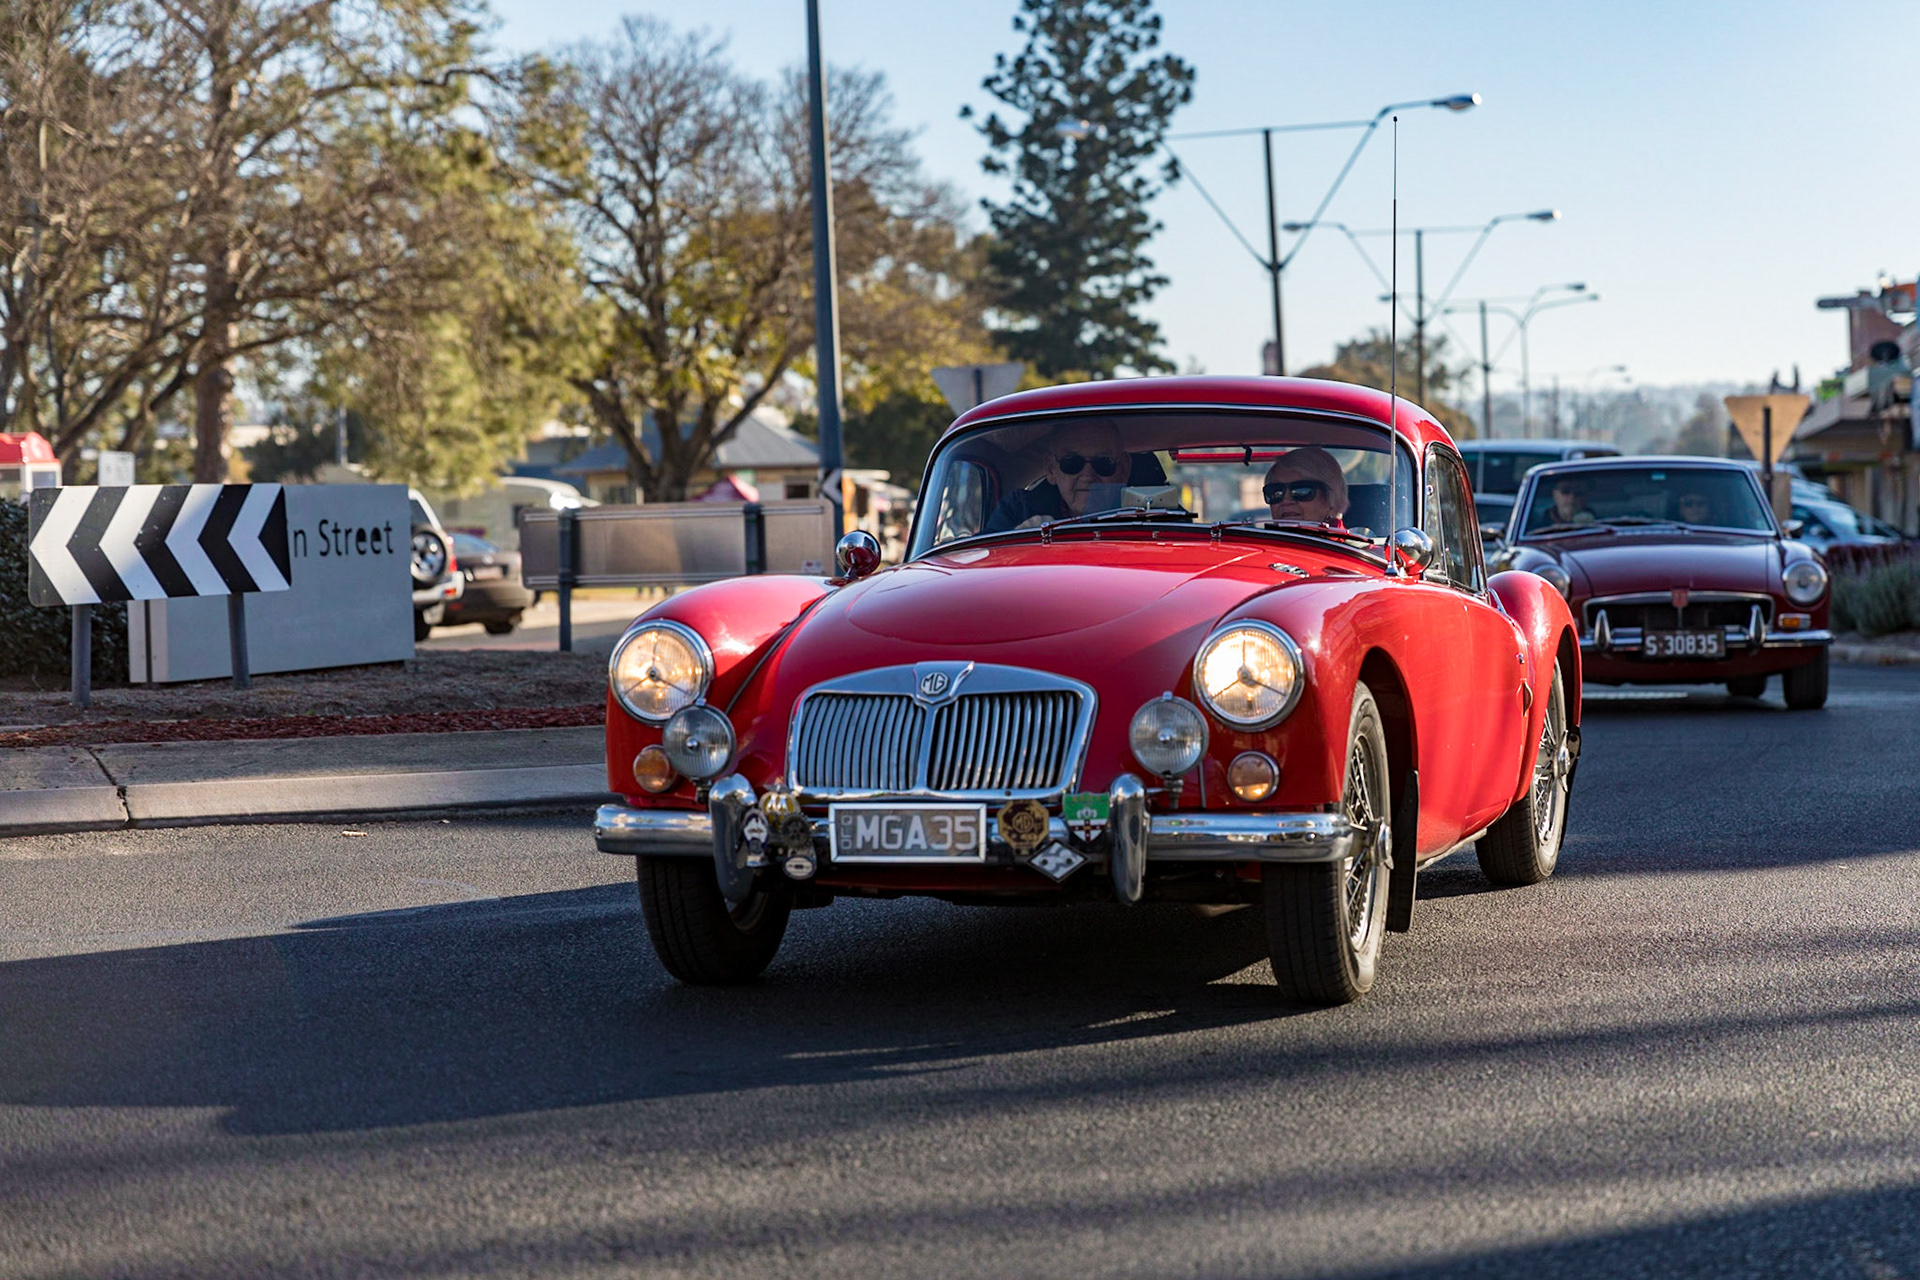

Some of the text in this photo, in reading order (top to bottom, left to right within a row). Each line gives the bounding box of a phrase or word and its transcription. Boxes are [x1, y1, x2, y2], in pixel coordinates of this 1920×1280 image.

[318, 519, 393, 556] Street
[922, 673, 947, 692] MG
[856, 814, 977, 850] MGA35
